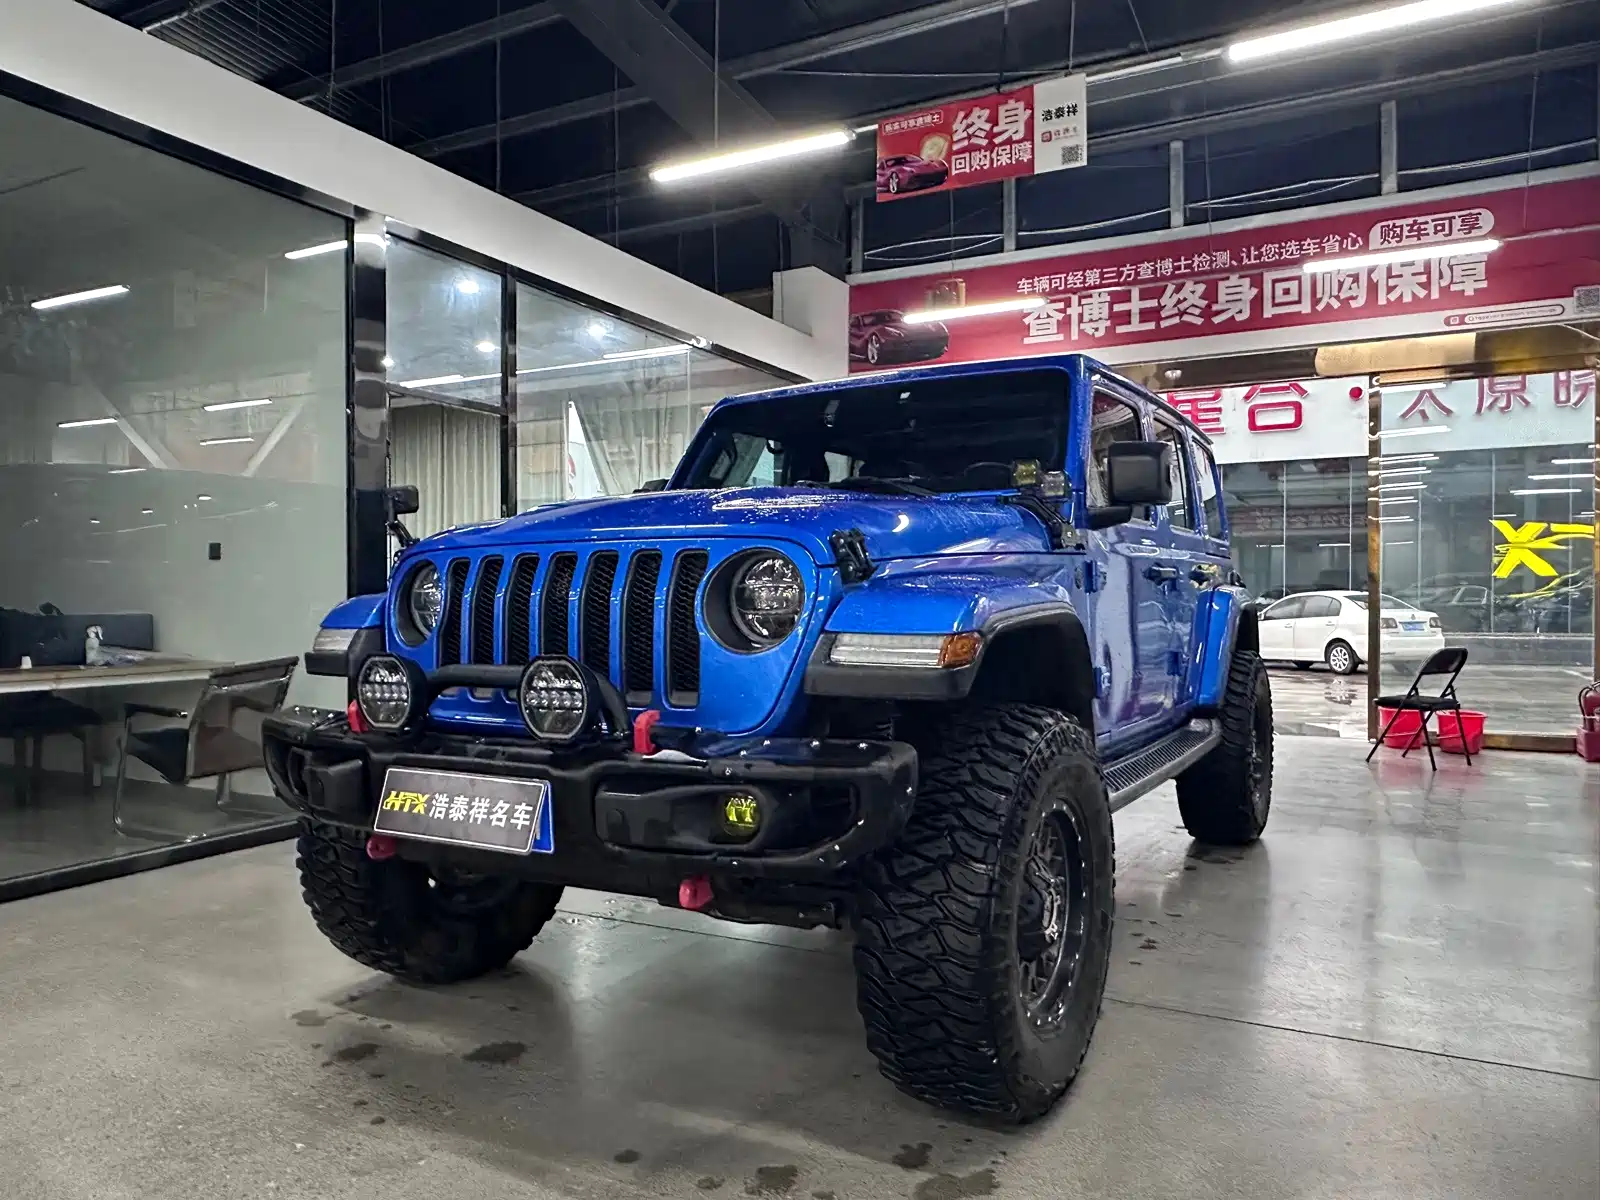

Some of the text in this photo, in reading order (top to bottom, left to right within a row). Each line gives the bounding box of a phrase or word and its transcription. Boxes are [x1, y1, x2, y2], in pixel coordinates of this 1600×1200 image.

[951, 100, 1032, 150] 终身
[1041, 103, 1078, 122] 浩泰祥
[951, 143, 1033, 176] 回购保障
[1379, 211, 1483, 246] 购车可享
[1022, 252, 1488, 345] 查博士终身回购保障
[429, 793, 533, 830] 浩泰祥名车
